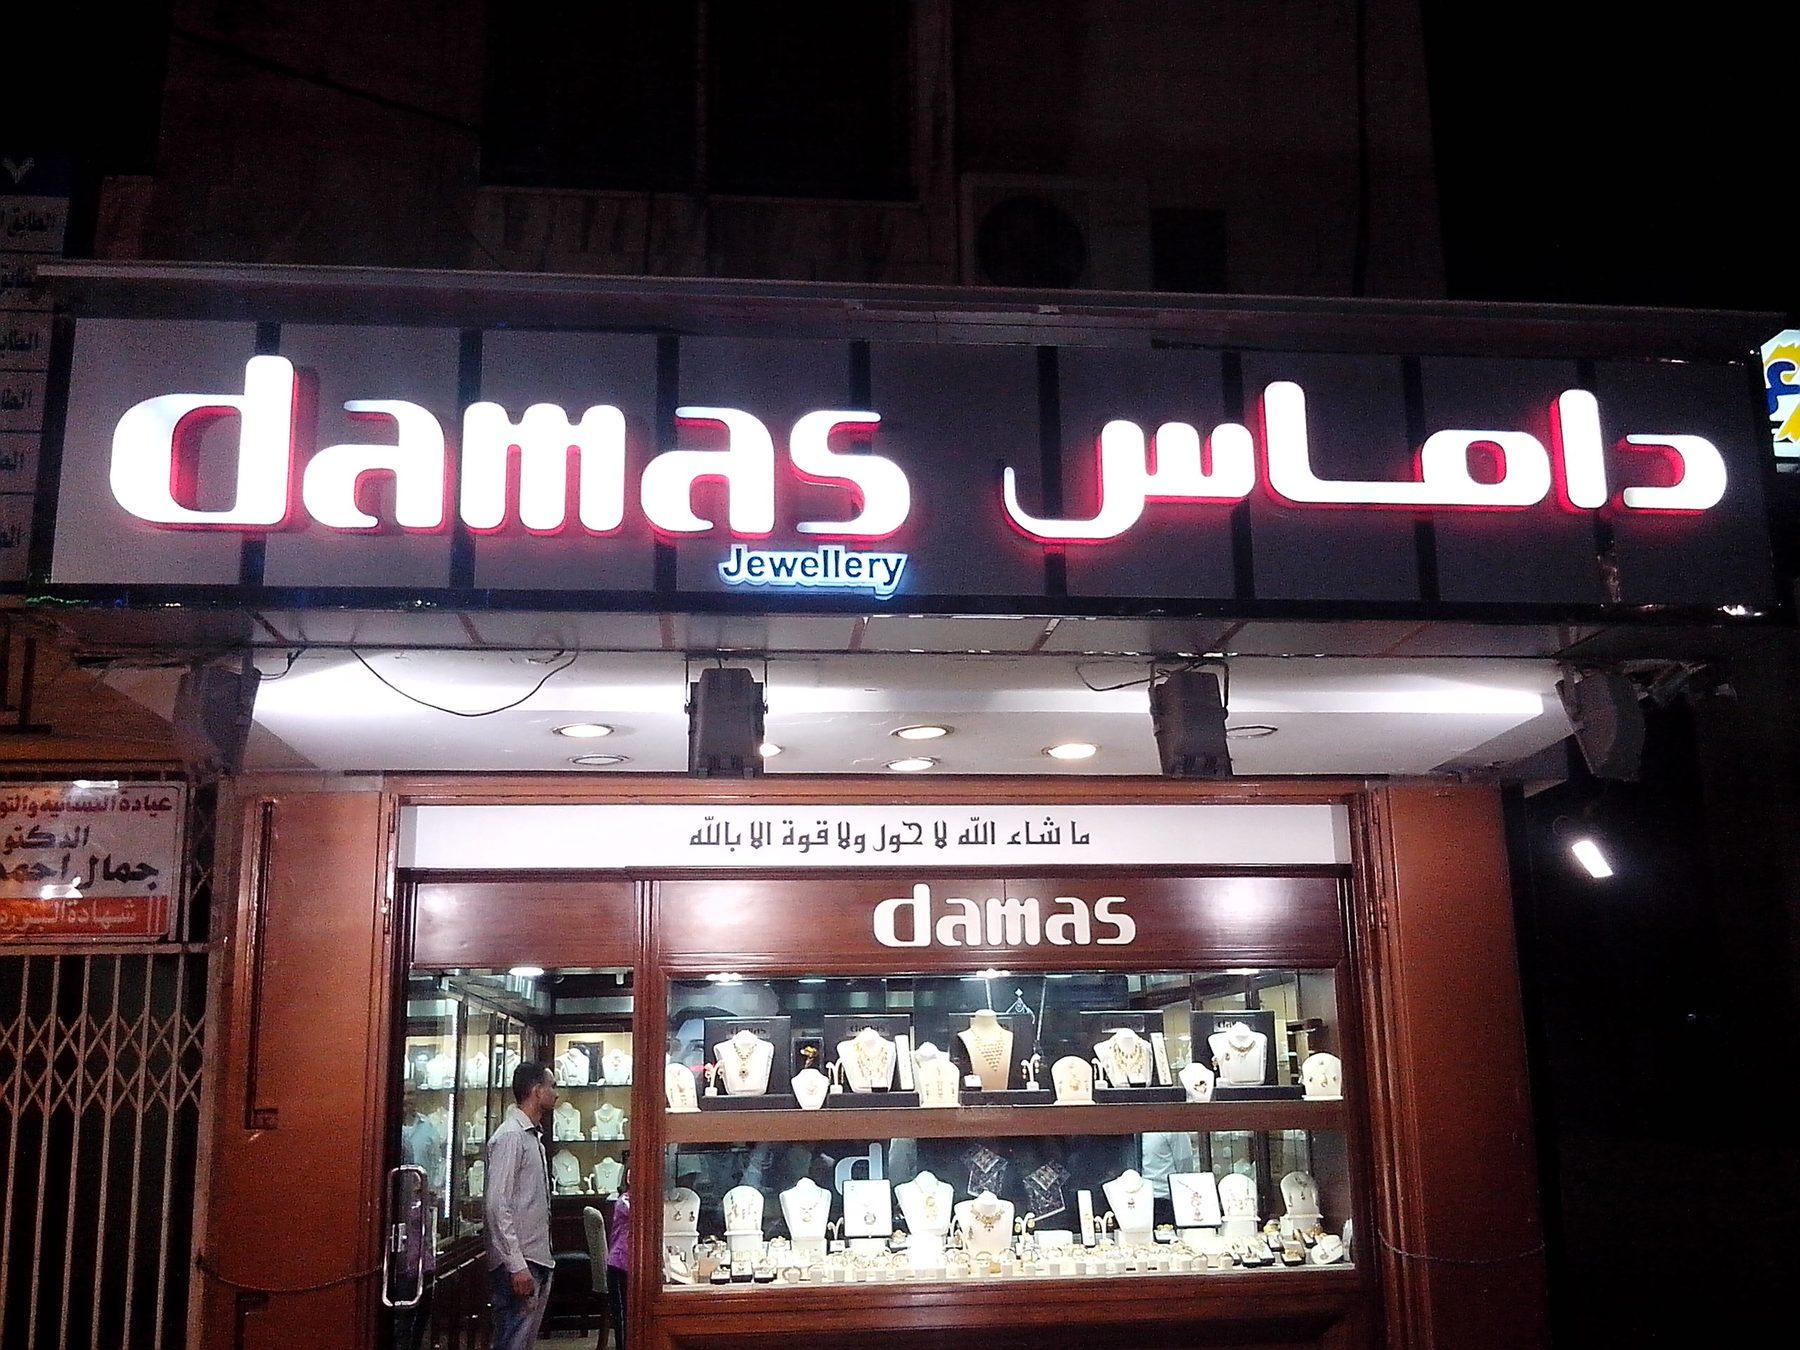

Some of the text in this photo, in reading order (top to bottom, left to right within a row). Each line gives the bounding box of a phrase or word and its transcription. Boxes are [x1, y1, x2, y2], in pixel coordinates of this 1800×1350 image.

[109, 354, 912, 536] damas
[1003, 380, 1728, 540] داماس
[722, 547, 903, 587] Jewellery
[782, 820, 829, 854] قوة
[872, 820, 923, 853] حول
[934, 819, 948, 849] لا
[1007, 816, 1061, 845] شاء
[1071, 821, 1090, 845] ما
[873, 883, 1137, 948] damas
